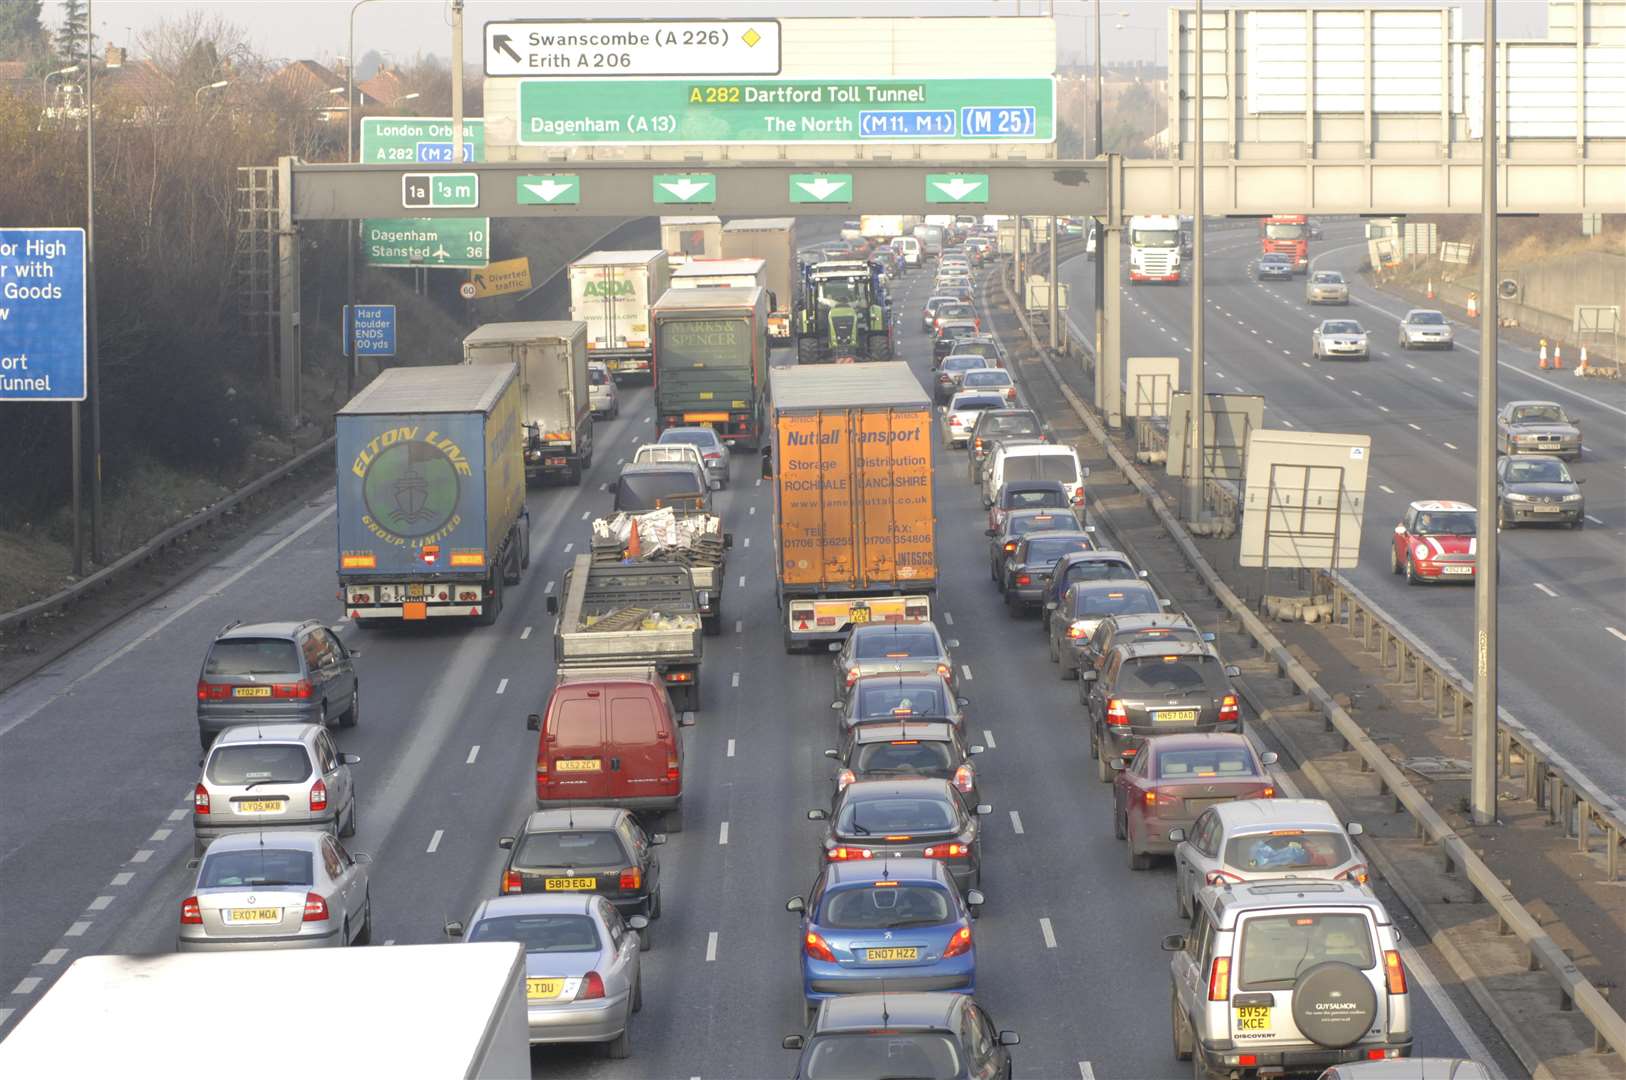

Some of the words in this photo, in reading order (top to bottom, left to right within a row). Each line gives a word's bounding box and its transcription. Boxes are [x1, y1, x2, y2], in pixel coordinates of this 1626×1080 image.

[529, 31, 650, 46] Swanscombe
[529, 53, 571, 67] Erith
[745, 86, 822, 103] Dartford
[827, 86, 860, 102] Toll
[866, 85, 925, 102] Tunnel
[376, 124, 423, 137] London
[428, 124, 474, 137] Orbal
[531, 116, 620, 134] Dagenham
[764, 116, 796, 132] The
[801, 116, 852, 132] North
[409, 184, 425, 198] 1a
[455, 185, 470, 198] m
[371, 228, 438, 243] Dagenham
[467, 230, 483, 242] 10
[25, 239, 66, 259] High
[371, 244, 431, 258] Stansted
[466, 246, 483, 259] 36
[15, 262, 53, 278] with
[489, 270, 528, 282] Diverted
[4, 282, 62, 300] Goods
[463, 286, 475, 295] 60
[495, 280, 525, 290] traffic
[583, 280, 636, 296] ASDA
[358, 309, 382, 318] Hard
[354, 320, 391, 329] houlder
[672, 321, 721, 333] MARKS
[355, 329, 384, 338] ENDS
[672, 333, 737, 345] SPENCER
[372, 339, 389, 350] yds
[352, 426, 419, 478] ELTON
[425, 430, 473, 476] LINE
[788, 458, 837, 471] Storage
[785, 479, 847, 492] ROCHDALE
[362, 515, 405, 545] GROUP
[411, 515, 461, 548] LIMITED
[572, 879, 592, 888] EGJ
[868, 949, 894, 960] EN07
[534, 983, 554, 993] TDU
[1239, 1006, 1268, 1017] BV52
[1243, 1018, 1265, 1029] KCE
